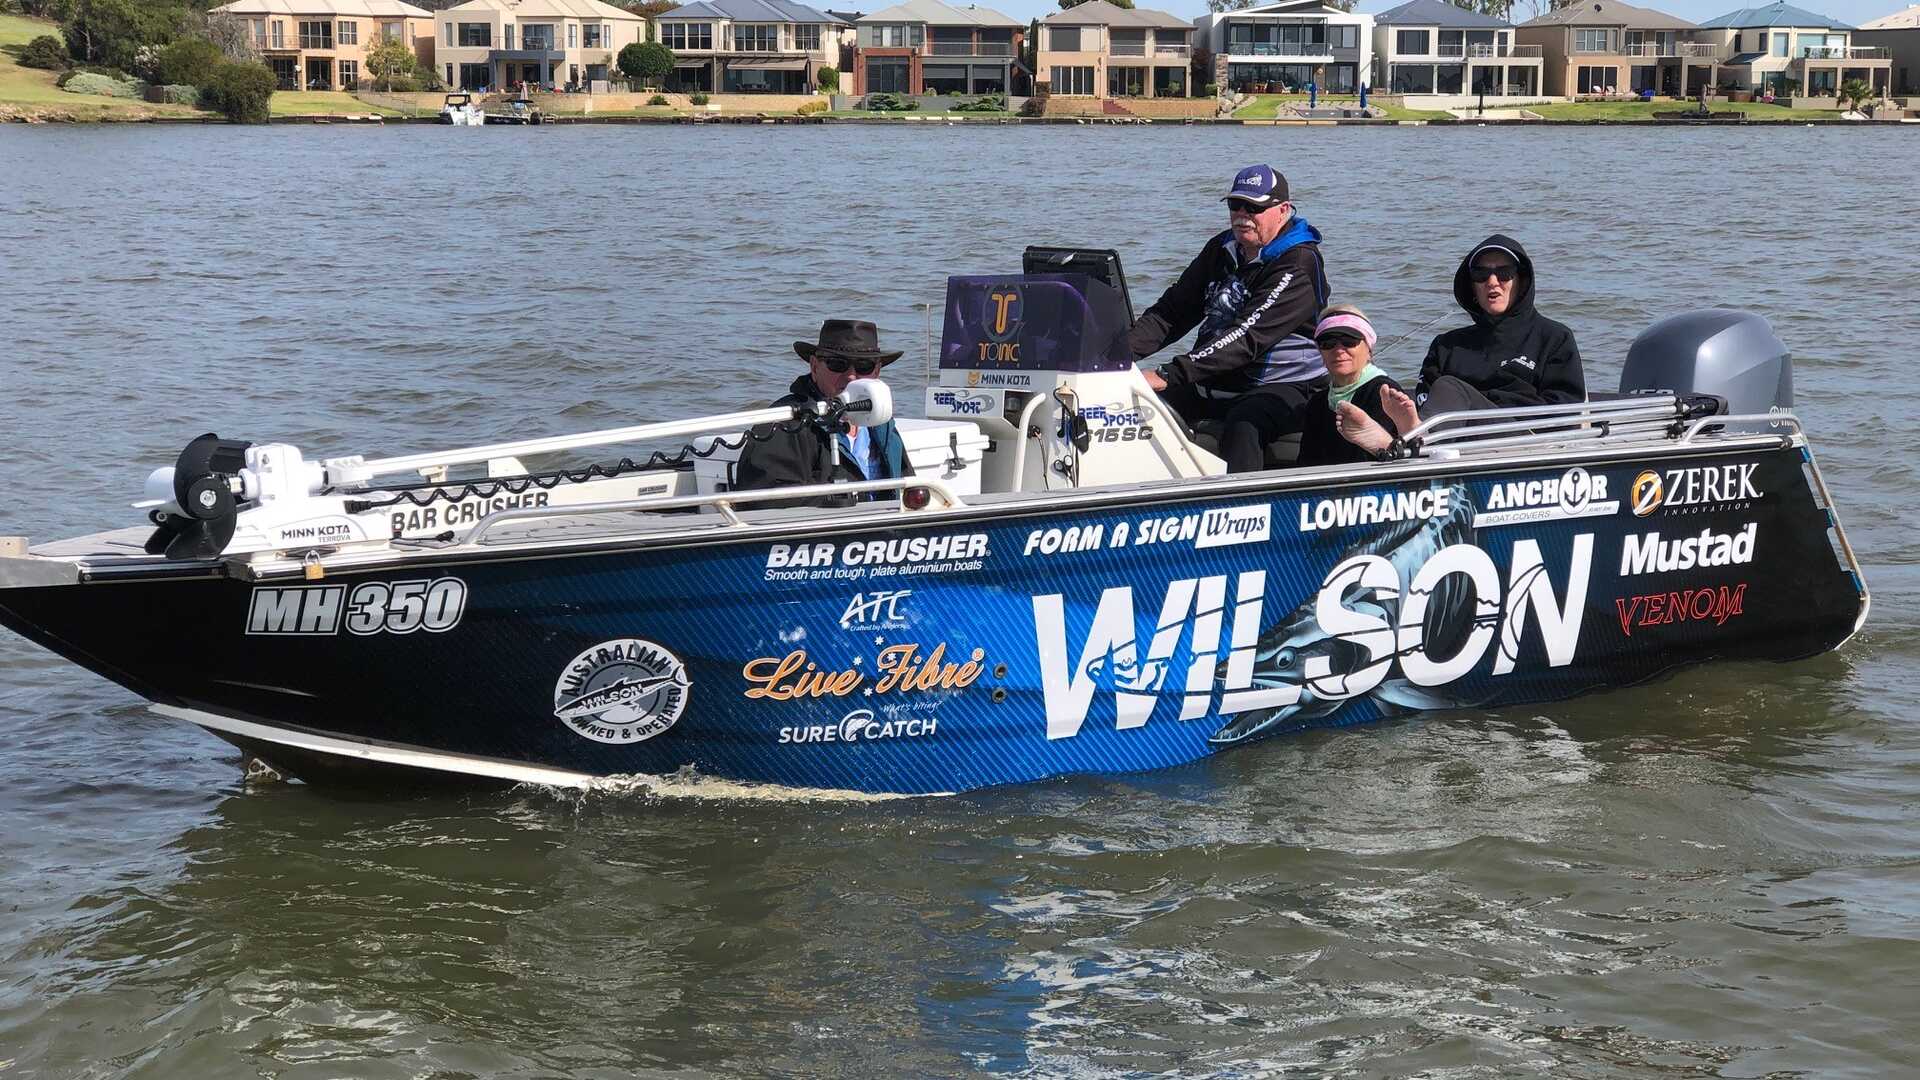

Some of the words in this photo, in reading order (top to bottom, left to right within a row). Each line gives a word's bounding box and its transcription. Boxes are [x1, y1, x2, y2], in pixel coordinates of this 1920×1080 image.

[981, 373, 1005, 385] MINN
[1006, 375, 1031, 386] KOTA
[391, 508, 437, 532] BAR
[444, 491, 549, 524] CRUSHER
[1300, 488, 1450, 531] LOWRANCE
[1487, 467, 1608, 514] ANCHOR
[1664, 502, 1751, 517] INNOVATION
[281, 527, 315, 540] MINN
[318, 525, 351, 535] KOTA
[1023, 524, 1104, 556] FORM
[1109, 522, 1130, 548] A
[1135, 514, 1200, 545] SIGN
[1206, 512, 1266, 539] Wraps
[1486, 513, 1511, 524] BOAT
[1513, 510, 1551, 521] COVERS
[318, 535, 351, 543] TERROVA
[766, 543, 835, 568] BAR
[842, 534, 989, 566] CRUSHER
[1620, 522, 1758, 576] Mustad
[764, 569, 808, 581] Smooth
[810, 567, 832, 580] and
[870, 565, 896, 579] plate
[899, 561, 952, 575] aluminium
[954, 560, 982, 571] boats
[245, 584, 347, 636] MH
[346, 577, 467, 636] 350
[839, 590, 912, 624] ATC
[1615, 583, 1747, 636] VENOM
[1032, 533, 1595, 740] WILSON
[561, 644, 671, 697] AUSTRALIAN
[743, 649, 863, 700] Live
[570, 715, 615, 739] OWNED
[622, 728, 631, 739] &
[636, 688, 682, 736] OPERATED
[581, 683, 644, 710] WILSON
